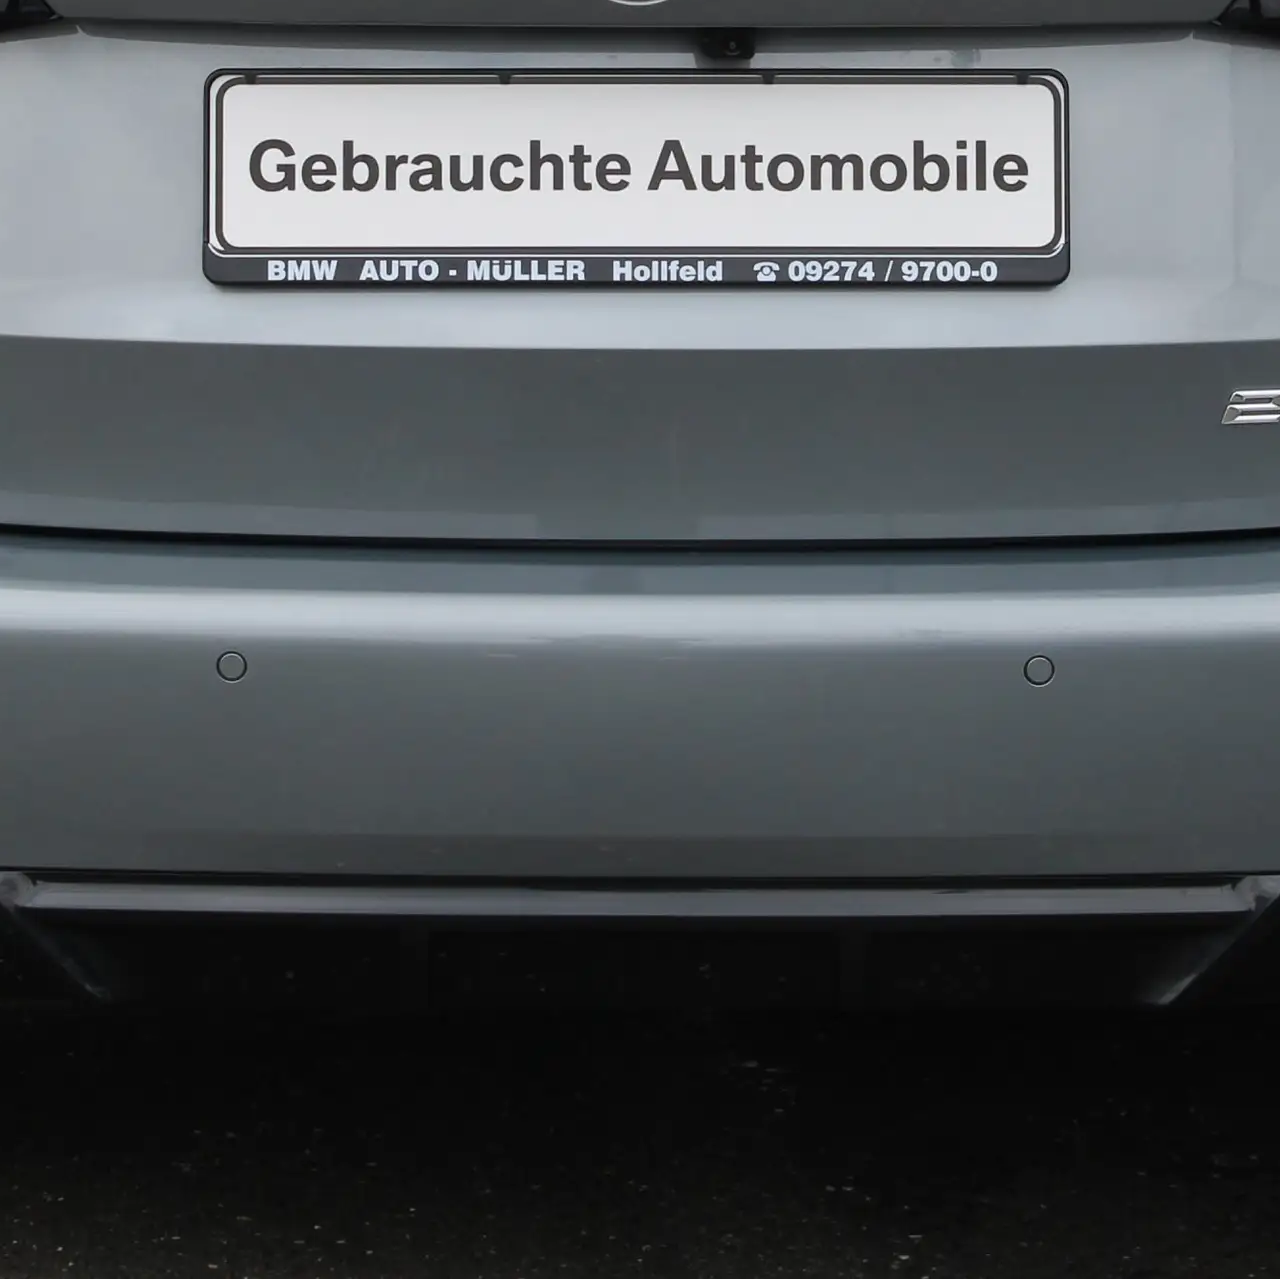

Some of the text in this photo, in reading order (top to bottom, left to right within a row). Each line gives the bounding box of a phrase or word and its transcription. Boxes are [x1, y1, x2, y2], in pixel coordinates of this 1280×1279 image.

[248, 138, 1029, 193] Gebrauchte Automobile
[267, 260, 338, 281] BMW
[358, 260, 440, 281] AUTO
[466, 260, 586, 281] MÜLLER
[611, 260, 723, 282] Hollfeld
[787, 260, 876, 282] 09274
[900, 260, 998, 282] 9700-0
